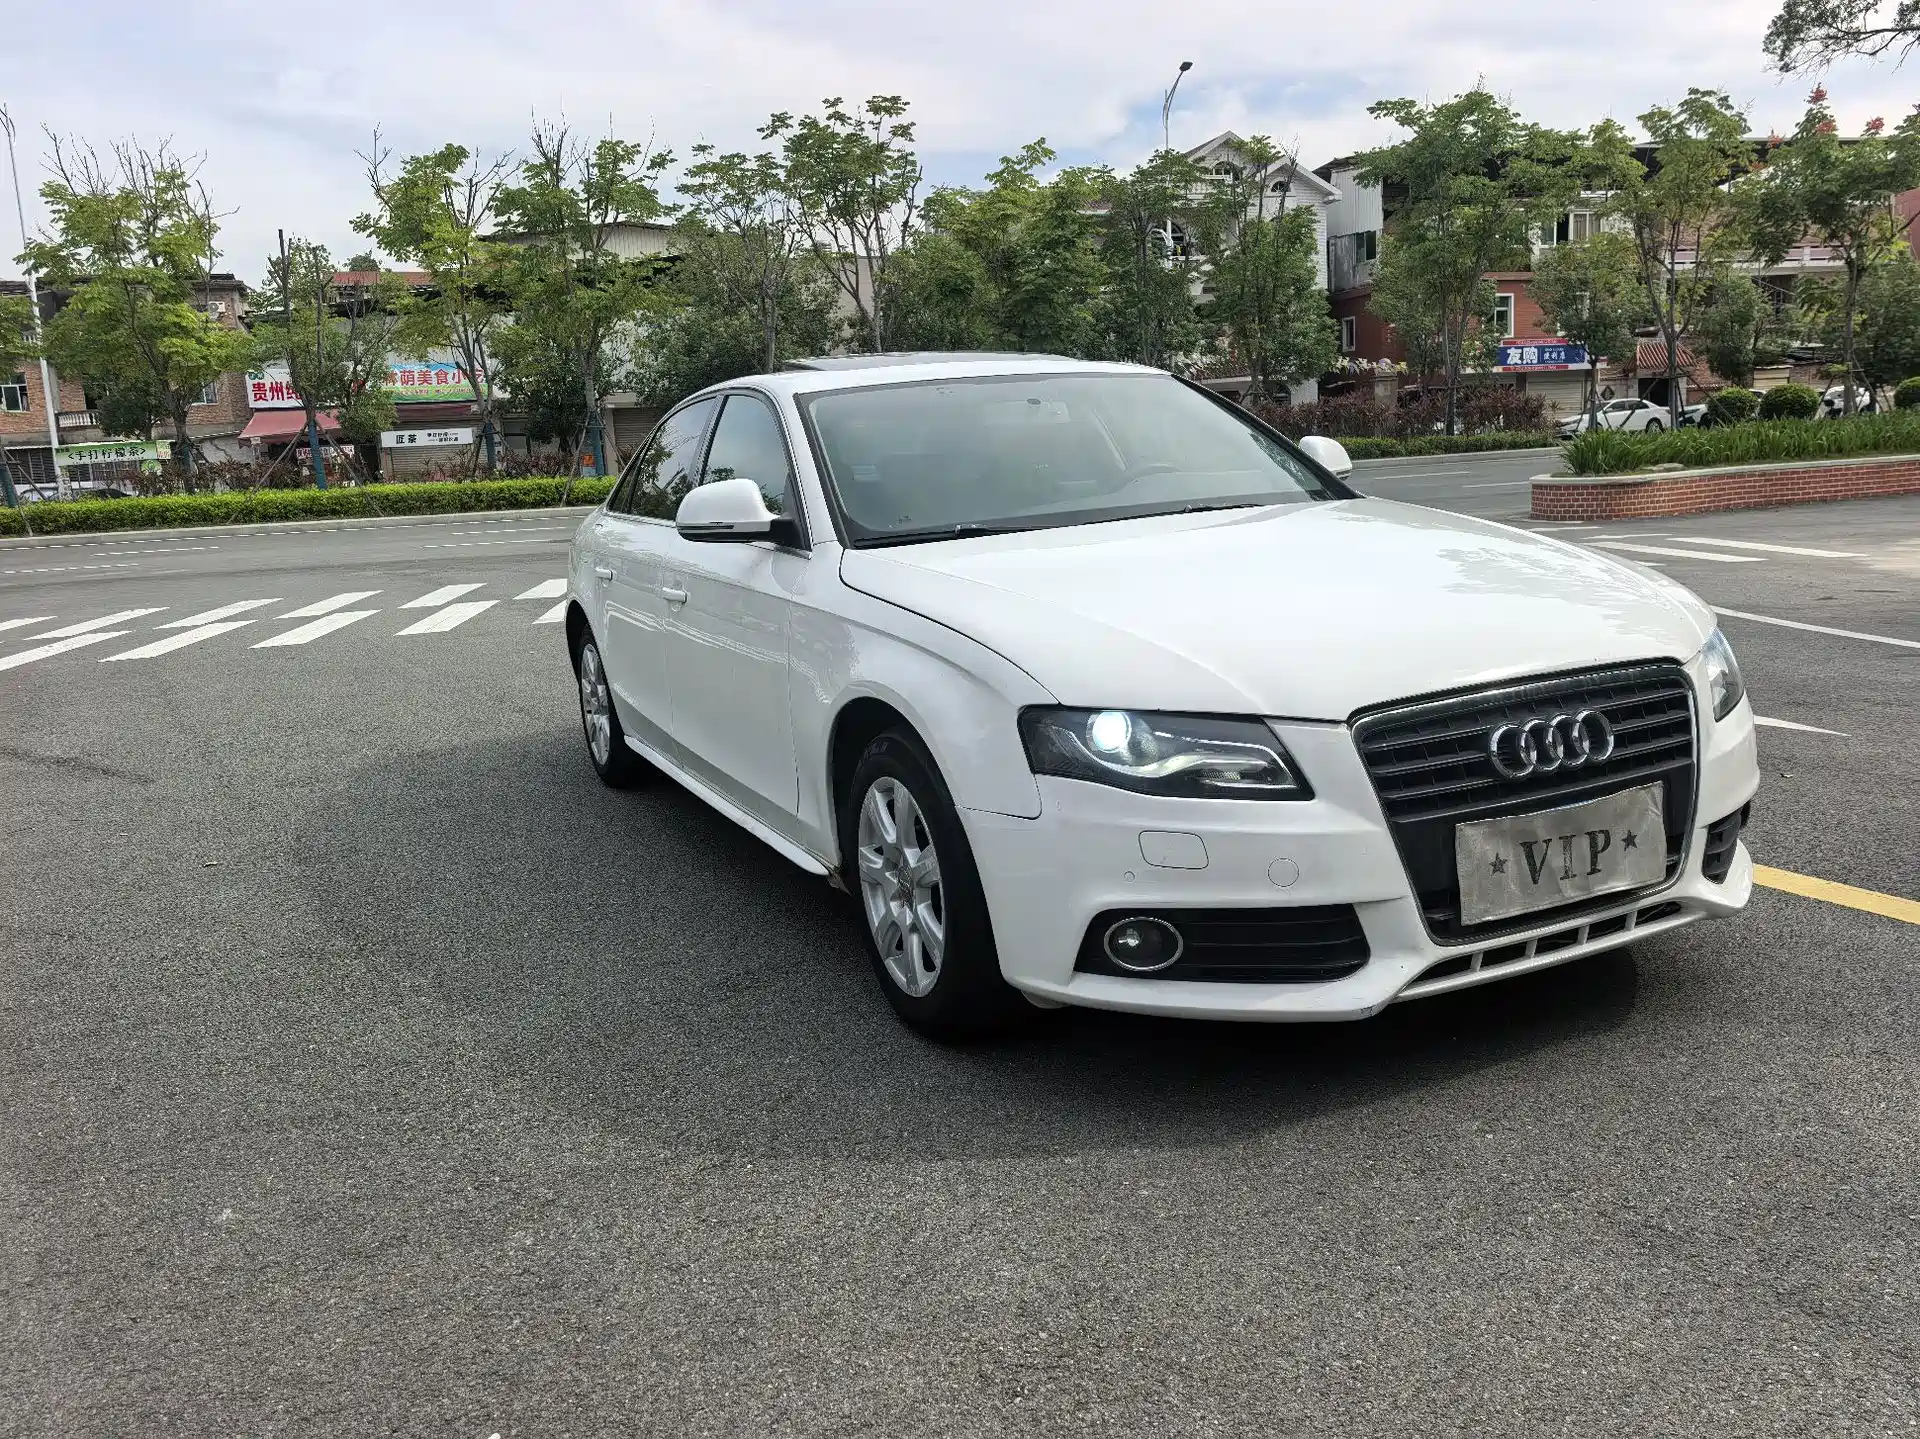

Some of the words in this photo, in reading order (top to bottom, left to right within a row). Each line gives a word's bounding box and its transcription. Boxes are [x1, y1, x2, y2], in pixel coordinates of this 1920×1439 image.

[1506, 346, 1538, 365] 友购
[395, 434, 417, 445] 匠茶
[1519, 829, 1612, 885] VIP
